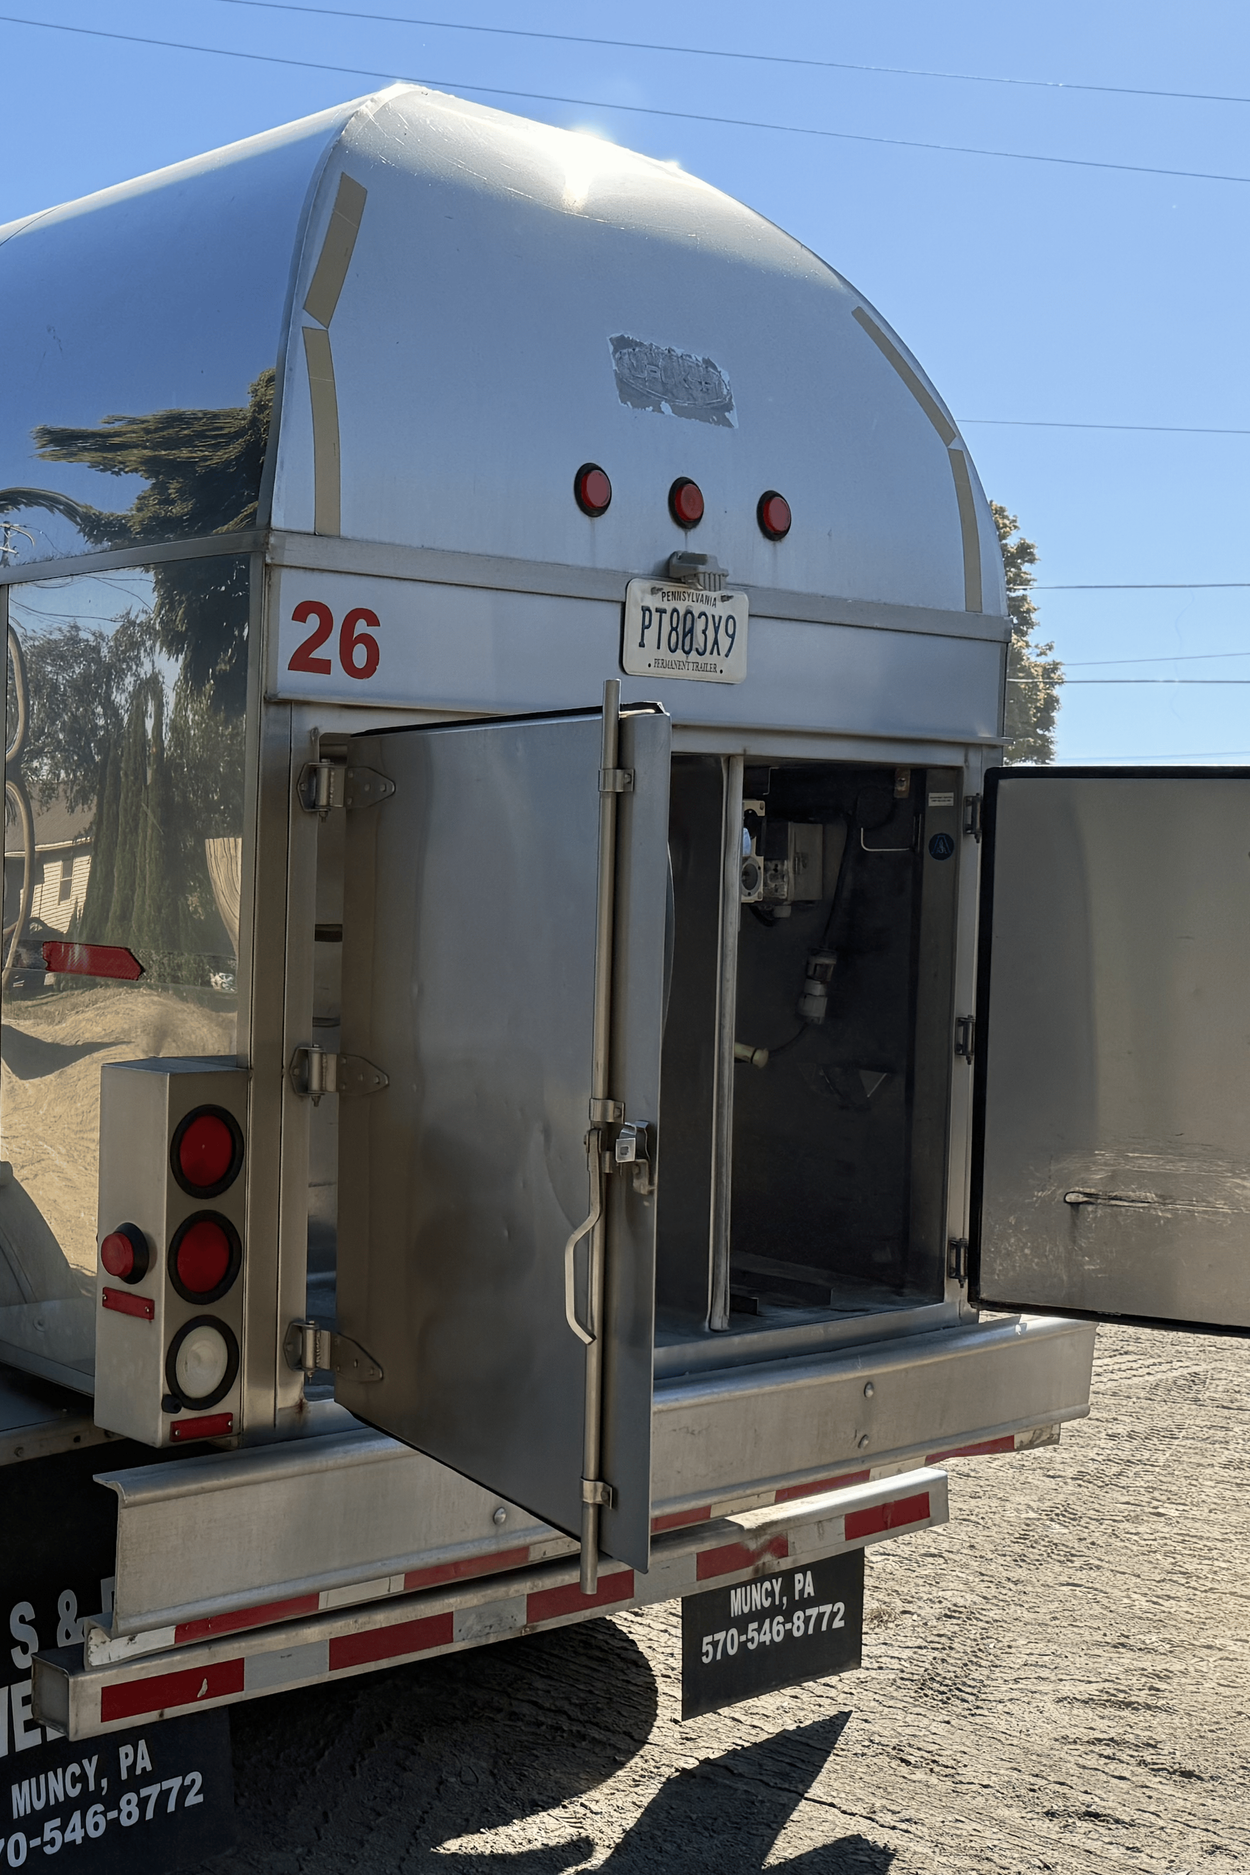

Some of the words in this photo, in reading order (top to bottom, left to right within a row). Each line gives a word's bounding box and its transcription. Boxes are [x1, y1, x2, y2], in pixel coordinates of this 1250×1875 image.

[661, 590, 717, 608] PENNSYLVANIA
[288, 600, 381, 680] 26
[638, 605, 737, 658] PT803X9
[653, 658, 690, 671] PERMANENT
[691, 660, 718, 673] TRAILER
[730, 1577, 787, 1618] MUNCY,
[794, 1570, 815, 1601] PA
[9, 1601, 39, 1669] S
[56, 1589, 85, 1648] &
[701, 1602, 845, 1664] 570-546-8772
[11, 1755, 108, 1820] MUNCY,
[119, 1739, 152, 1781] PA
